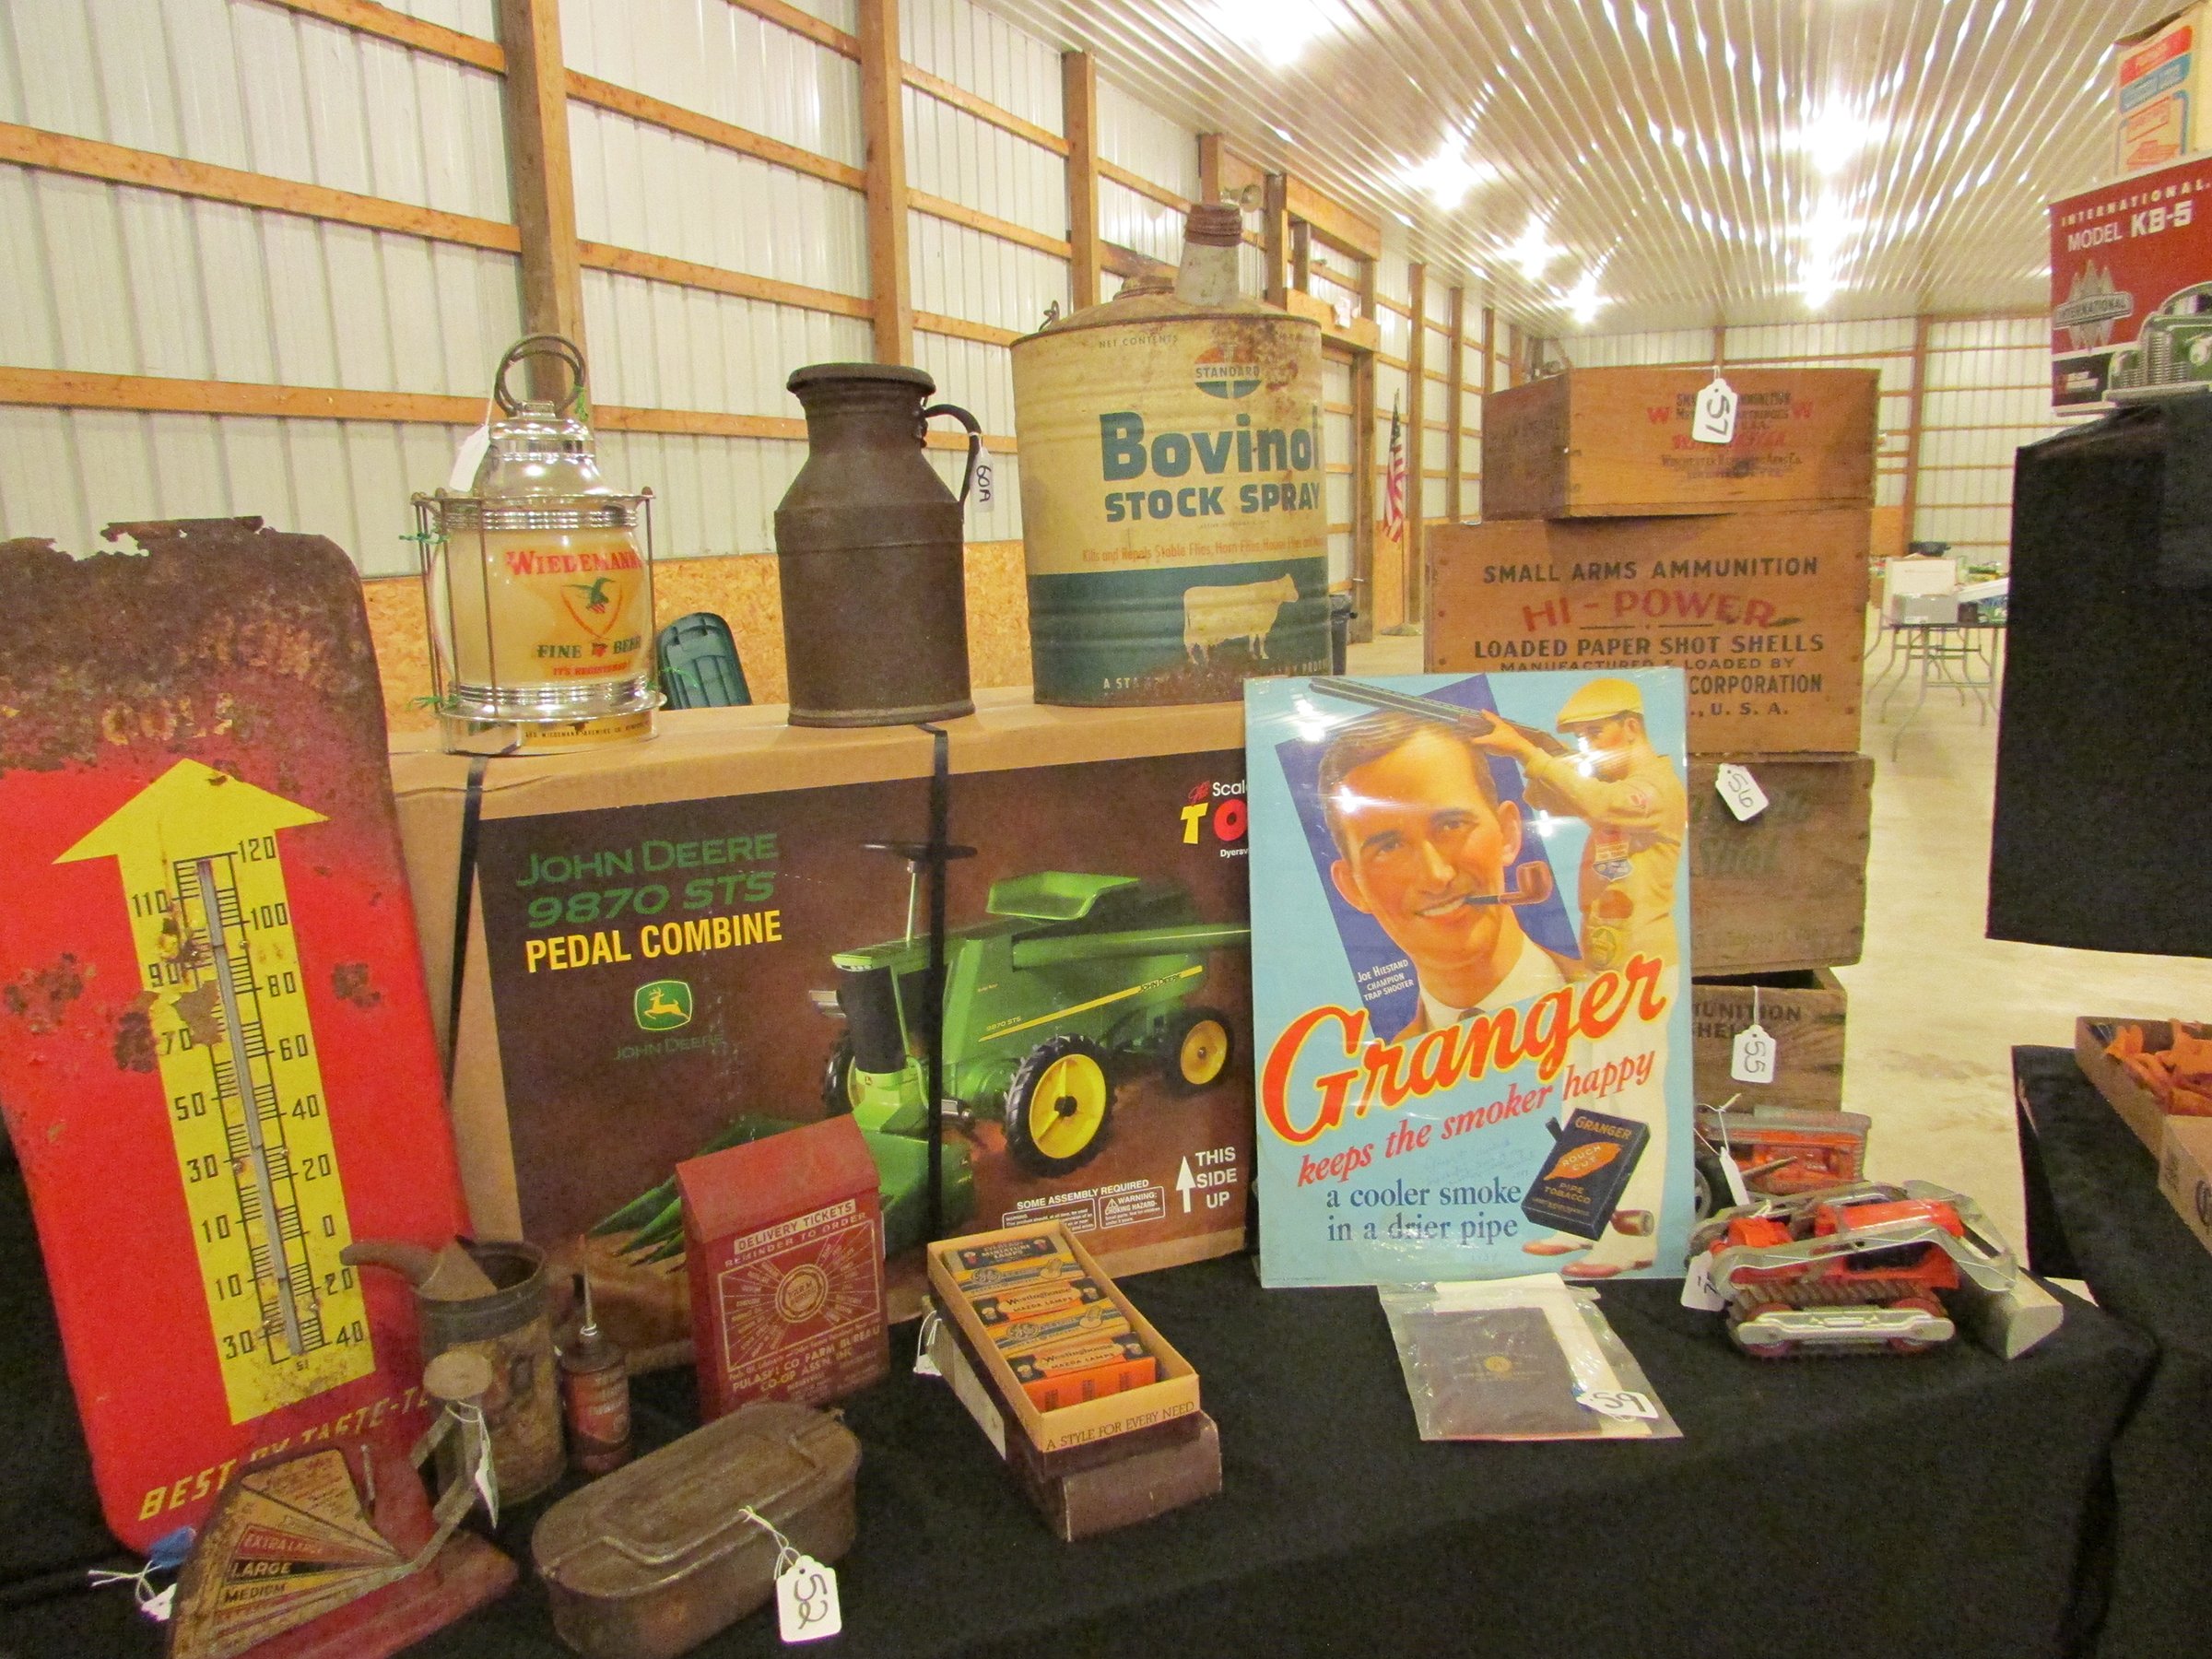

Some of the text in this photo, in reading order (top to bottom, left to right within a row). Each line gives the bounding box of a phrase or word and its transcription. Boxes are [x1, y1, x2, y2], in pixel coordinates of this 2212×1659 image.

[2067, 200, 2193, 253] MODEL KB-5
[1099, 335, 1179, 348] NET CONTENTS
[1194, 366, 1261, 379] STANDARD
[1705, 394, 1731, 436] 57
[1099, 405, 1320, 482] Bovinol
[976, 465, 993, 503] 60A
[1104, 482, 1321, 523] STOCK SPRAY
[1155, 544, 1185, 559] Stable
[1483, 556, 1819, 583] SMALL ARMS AMMUNITION
[537, 635, 642, 659] FINE BEER
[1475, 633, 1824, 659] LOADED PAPER SHOT SHELLS
[1500, 659, 1654, 672] MANUFACTURED
[1684, 657, 1761, 670] LOADED
[1771, 658, 1795, 669] BY
[1688, 674, 1824, 695] CORPORATION
[1212, 779, 1247, 797] Scal
[1727, 773, 1754, 808] 56
[238, 835, 277, 865] 120
[516, 832, 780, 888] JOHN DEERE
[132, 888, 170, 918] 110
[527, 870, 777, 929] 9870 STS
[251, 902, 288, 932] 100
[525, 909, 782, 974] PEDAL COMBINE
[148, 961, 181, 988] 90
[268, 971, 297, 998] 80
[1357, 959, 1409, 983] JOE HIESTAND
[1366, 972, 1406, 991] CHAMPION
[1363, 979, 1415, 1002] TRAP SHOOTER
[161, 1027, 193, 1056] 70
[279, 1033, 310, 1062] 60
[615, 1034, 724, 1061] JOHN DEERE
[1261, 951, 1668, 1146] Granger
[1743, 1041, 1767, 1074] 55
[174, 1091, 206, 1122] 50
[291, 1093, 321, 1122] 40
[1296, 1142, 1375, 1187] keeps
[1384, 1120, 1432, 1159] the
[1440, 1083, 1554, 1141] smoker
[1562, 1050, 1656, 1101] happy
[1574, 1115, 1633, 1140] GRANGER
[187, 1153, 219, 1183] 30
[302, 1153, 332, 1182] 20
[1194, 1146, 1237, 1168] THIS
[1562, 1145, 1602, 1167] ROUGH
[1571, 1157, 1597, 1171] CUT
[1196, 1167, 1238, 1190] SIDE
[1326, 1177, 1522, 1208] a cooler smoke
[1559, 1182, 1584, 1194] PIPE
[1017, 1179, 1149, 1210] SOME ASSEMBLY REQUIRED
[1118, 1191, 1158, 1204] WARNING:
[1206, 1191, 1230, 1209] UP
[1544, 1186, 1593, 1205] TOBACCO
[201, 1214, 230, 1243] 10
[323, 1214, 337, 1238] 0
[724, 1212, 867, 1268] REMINDER TO ORDER
[738, 1201, 853, 1251] DELIVERY TICKETS
[1327, 1213, 1519, 1246] in a drier pipe
[215, 1272, 243, 1301] 10
[324, 1266, 354, 1296] 20
[1006, 1288, 1072, 1306] Westinghouse
[222, 1329, 254, 1360] 30
[335, 1320, 365, 1347] 40
[1041, 1343, 1113, 1364] Westinghouse
[1591, 1391, 1647, 1413] 59
[1045, 1401, 1195, 1451] A STYLE FOR EVERY NEED
[138, 1458, 237, 1522] BEST
[231, 1560, 294, 1578] LARGE
[224, 1583, 286, 1604] MEDIUM
